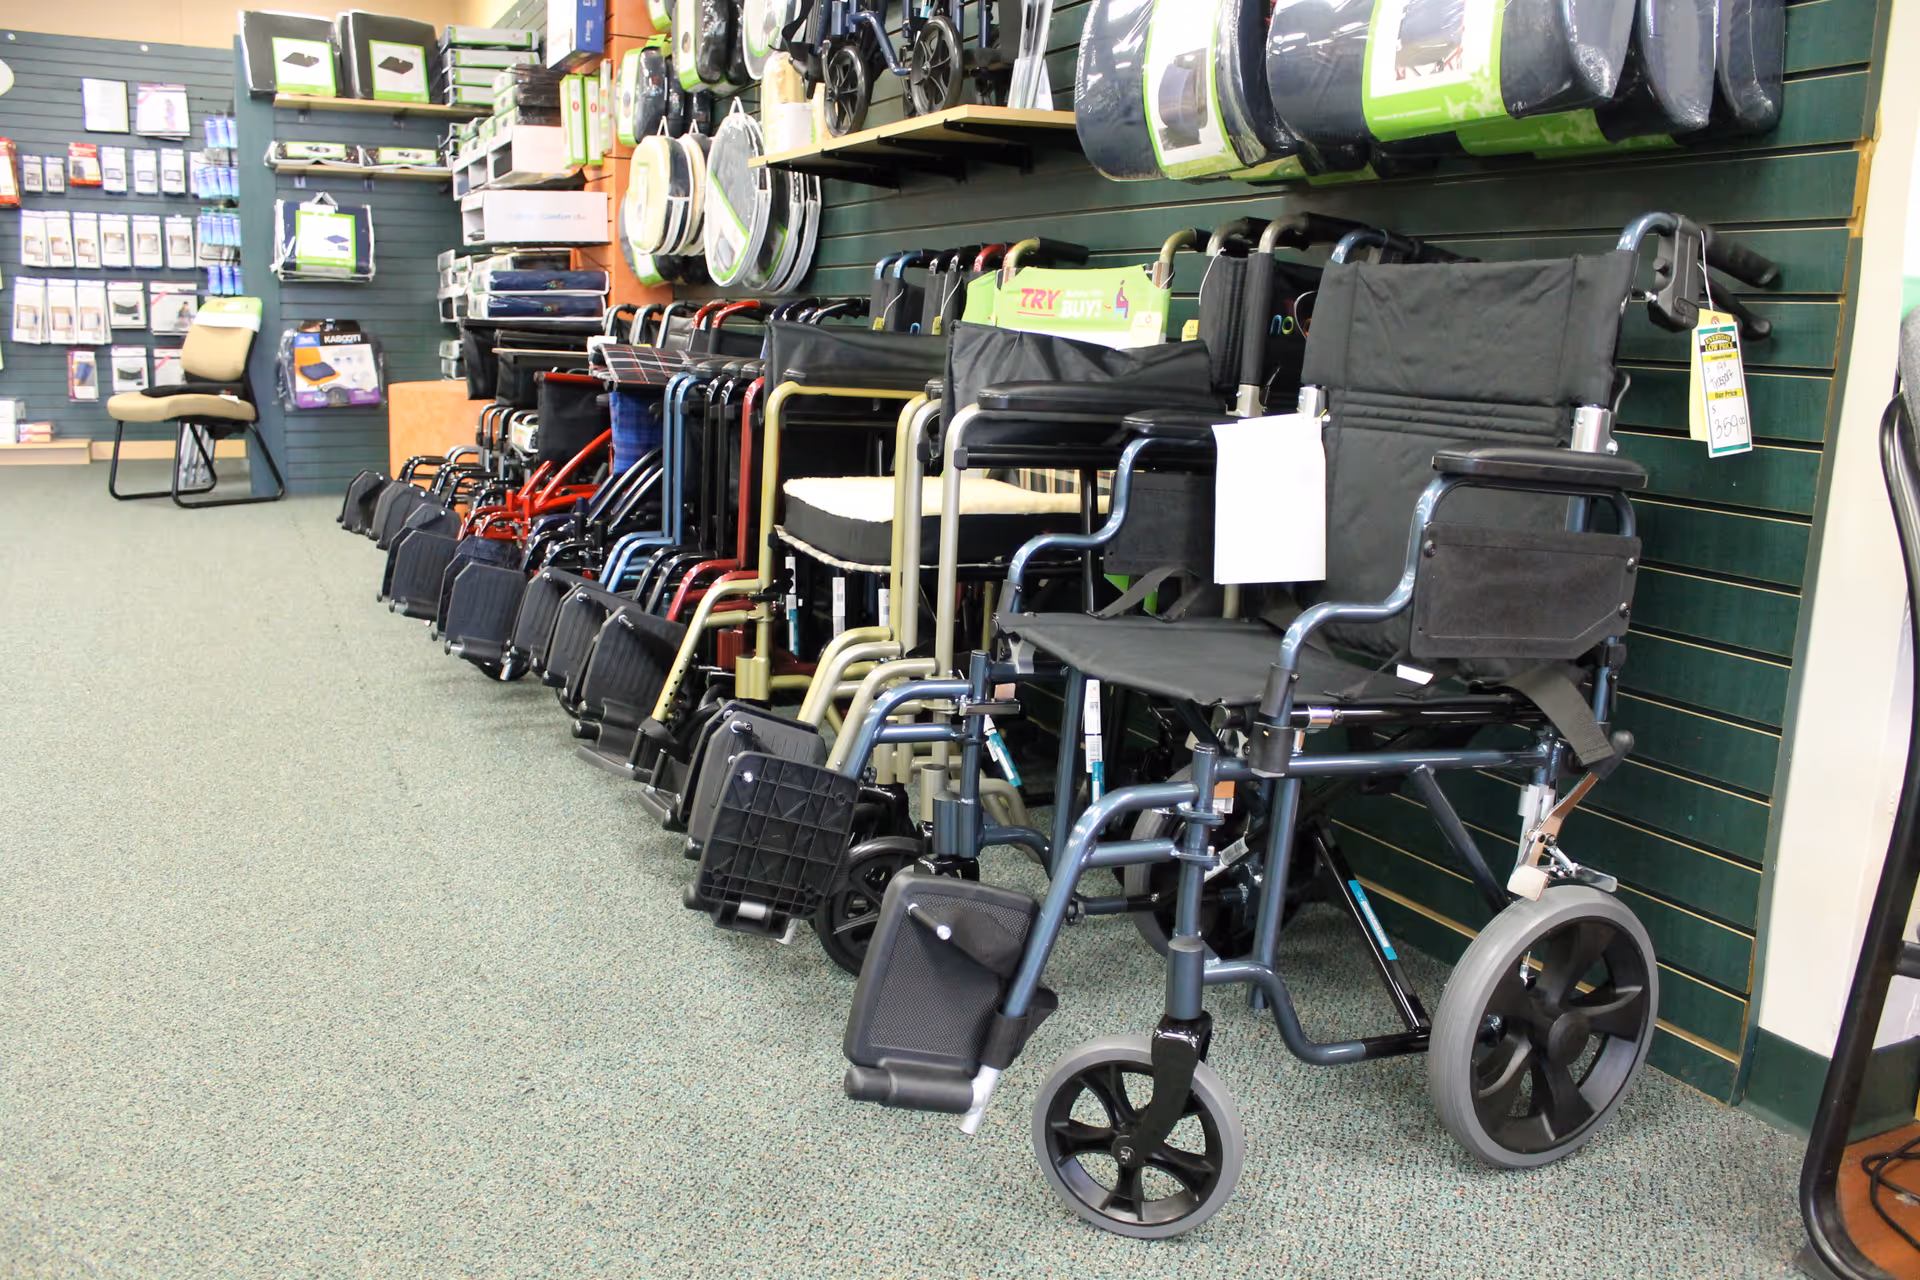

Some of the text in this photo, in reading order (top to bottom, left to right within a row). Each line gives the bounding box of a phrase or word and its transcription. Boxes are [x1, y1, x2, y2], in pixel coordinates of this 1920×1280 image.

[1020, 287, 1062, 310] TRY
[1059, 299, 1102, 318] BUY!
[1714, 391, 1724, 399] Our
